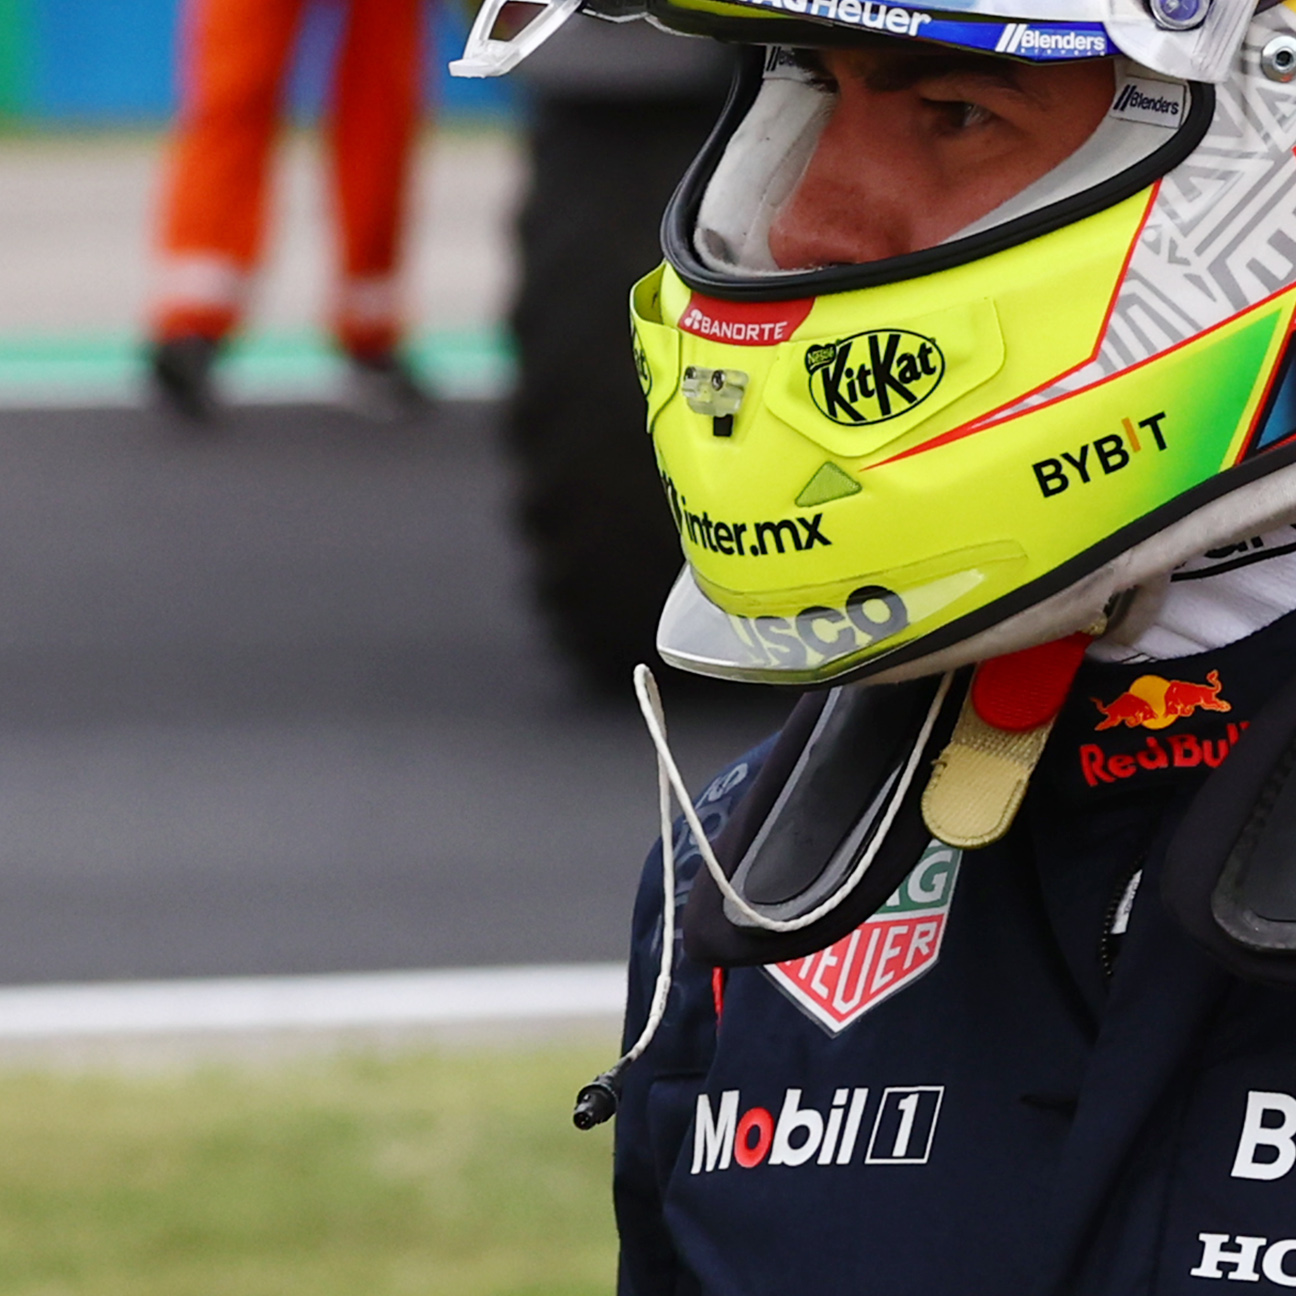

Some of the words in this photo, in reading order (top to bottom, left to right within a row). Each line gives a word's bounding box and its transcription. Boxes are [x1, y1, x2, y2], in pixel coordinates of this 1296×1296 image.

[1020, 30, 1105, 51] Blenders
[1129, 91, 1179, 115] Blenders
[701, 317, 788, 341] BANORTE
[821, 334, 937, 422] KitKat
[1031, 412, 1171, 499] BYBIT
[680, 495, 832, 557] inter.mx
[1080, 737, 1169, 787] Red
[691, 1088, 869, 1175] Mobil
